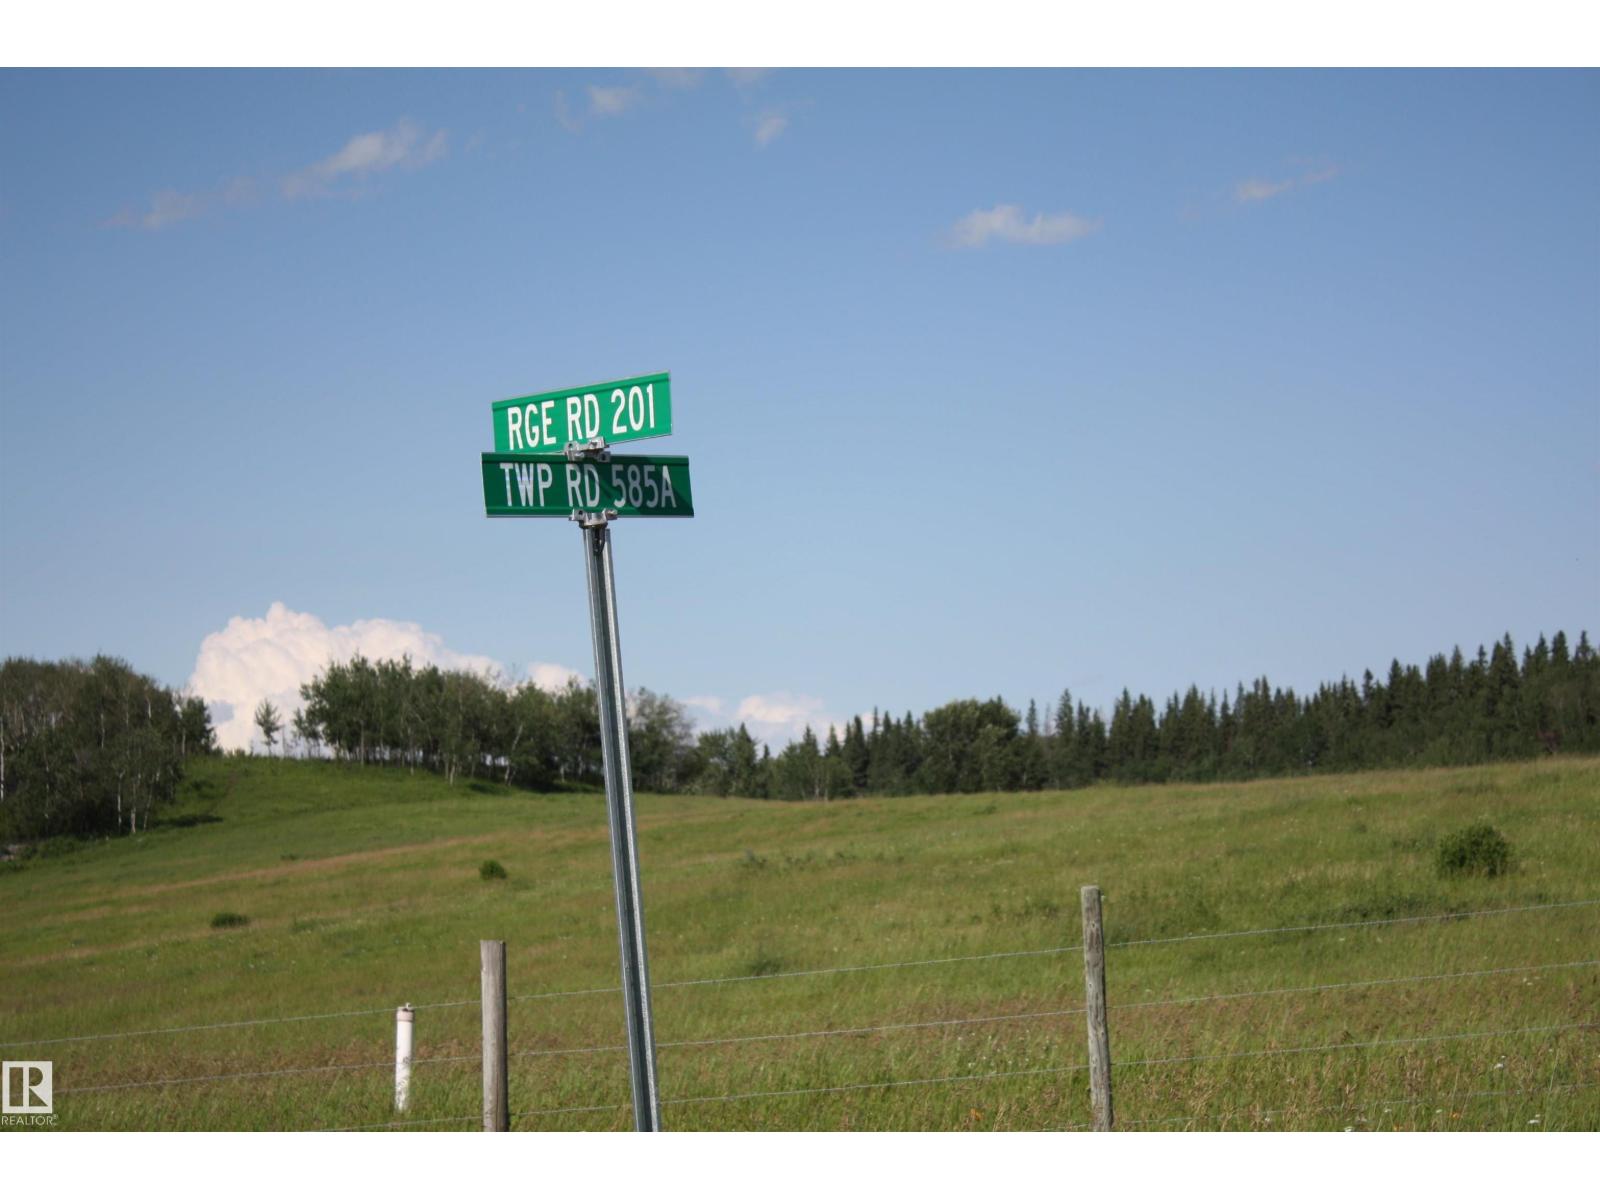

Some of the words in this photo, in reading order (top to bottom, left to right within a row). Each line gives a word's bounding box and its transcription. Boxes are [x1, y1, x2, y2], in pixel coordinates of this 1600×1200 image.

[507, 400, 557, 450] RGE
[566, 393, 600, 442] RD
[610, 383, 655, 435] 201
[500, 462, 553, 507] TWP
[565, 463, 600, 507] RD
[611, 464, 677, 508] 585A
